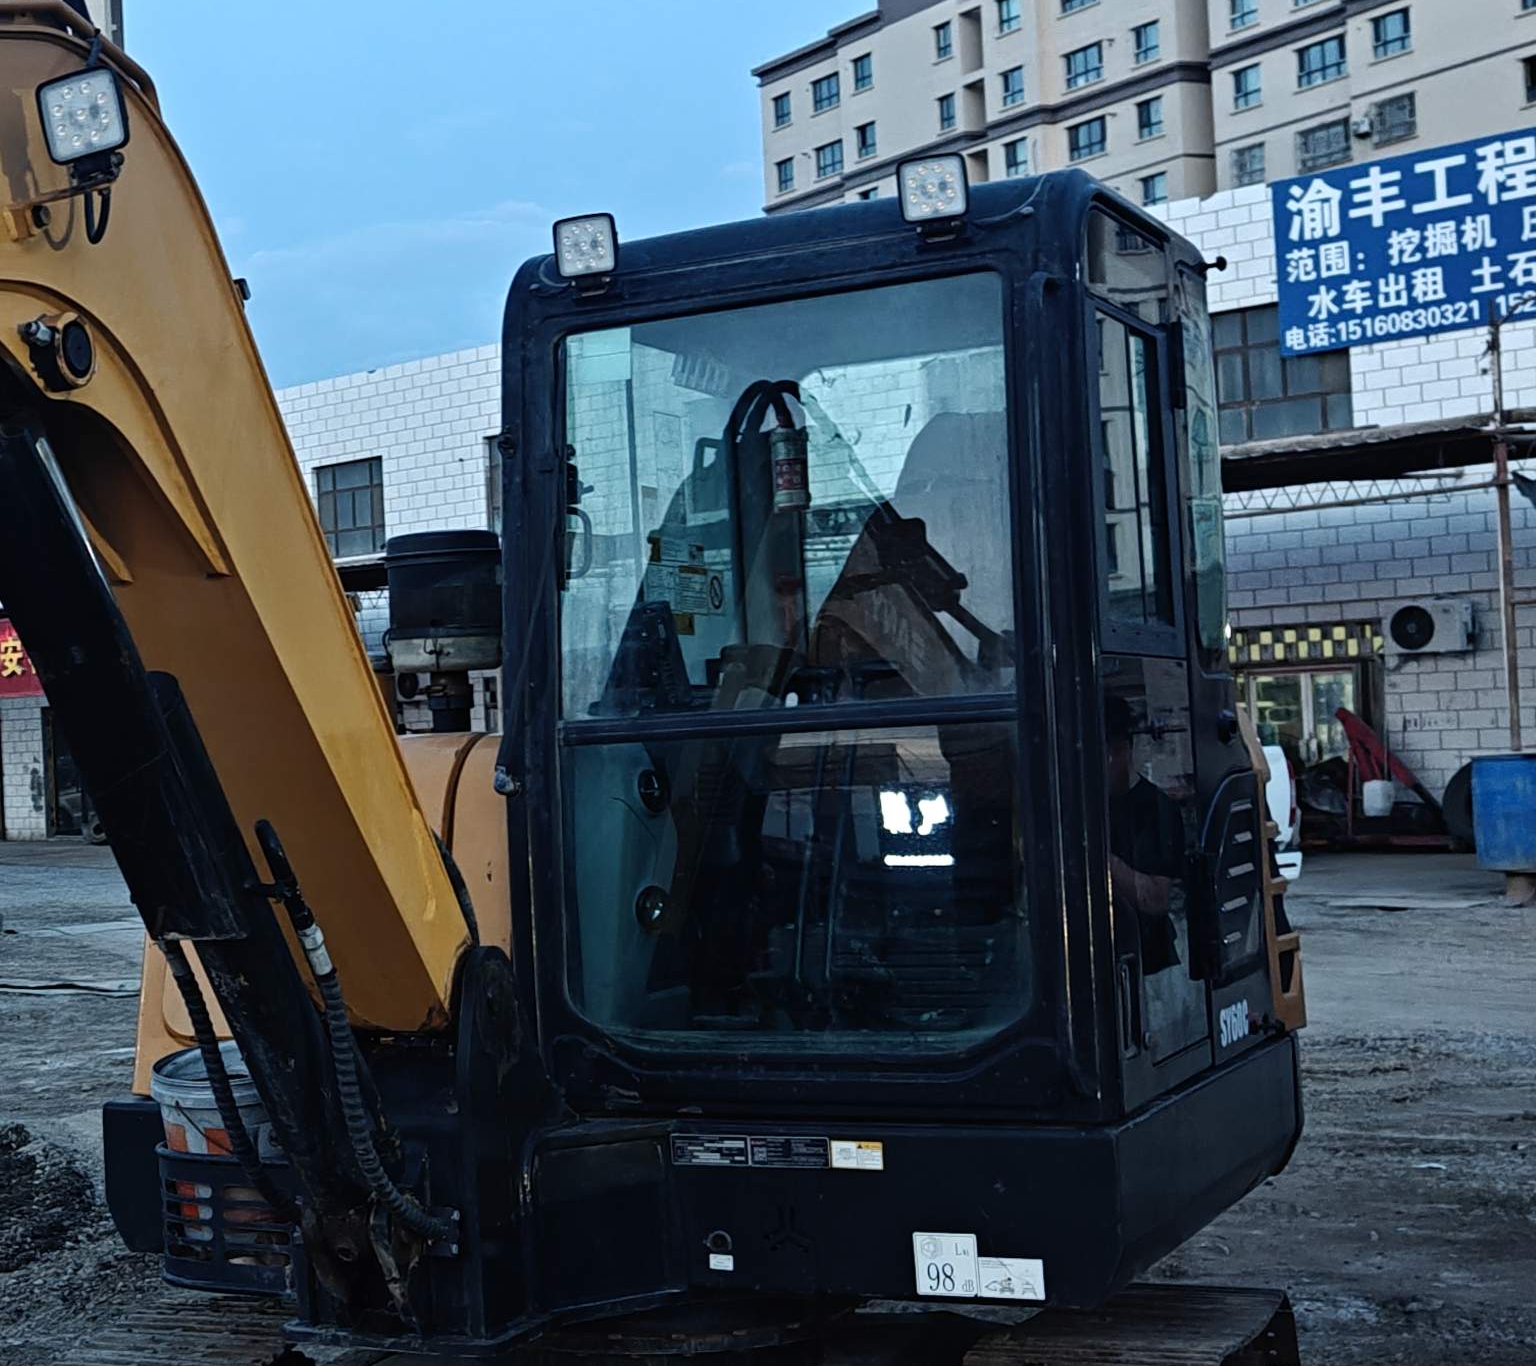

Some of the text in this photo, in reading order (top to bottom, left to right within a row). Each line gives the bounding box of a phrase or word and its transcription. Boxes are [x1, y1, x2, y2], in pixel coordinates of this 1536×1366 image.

[1285, 135, 1536, 242] 渝丰工程
[1387, 213, 1497, 267] 挖掘机
[1307, 249, 1536, 321] 水车出租 土石
[927, 1262, 956, 1292] 98
[961, 1279, 976, 1293] dB
